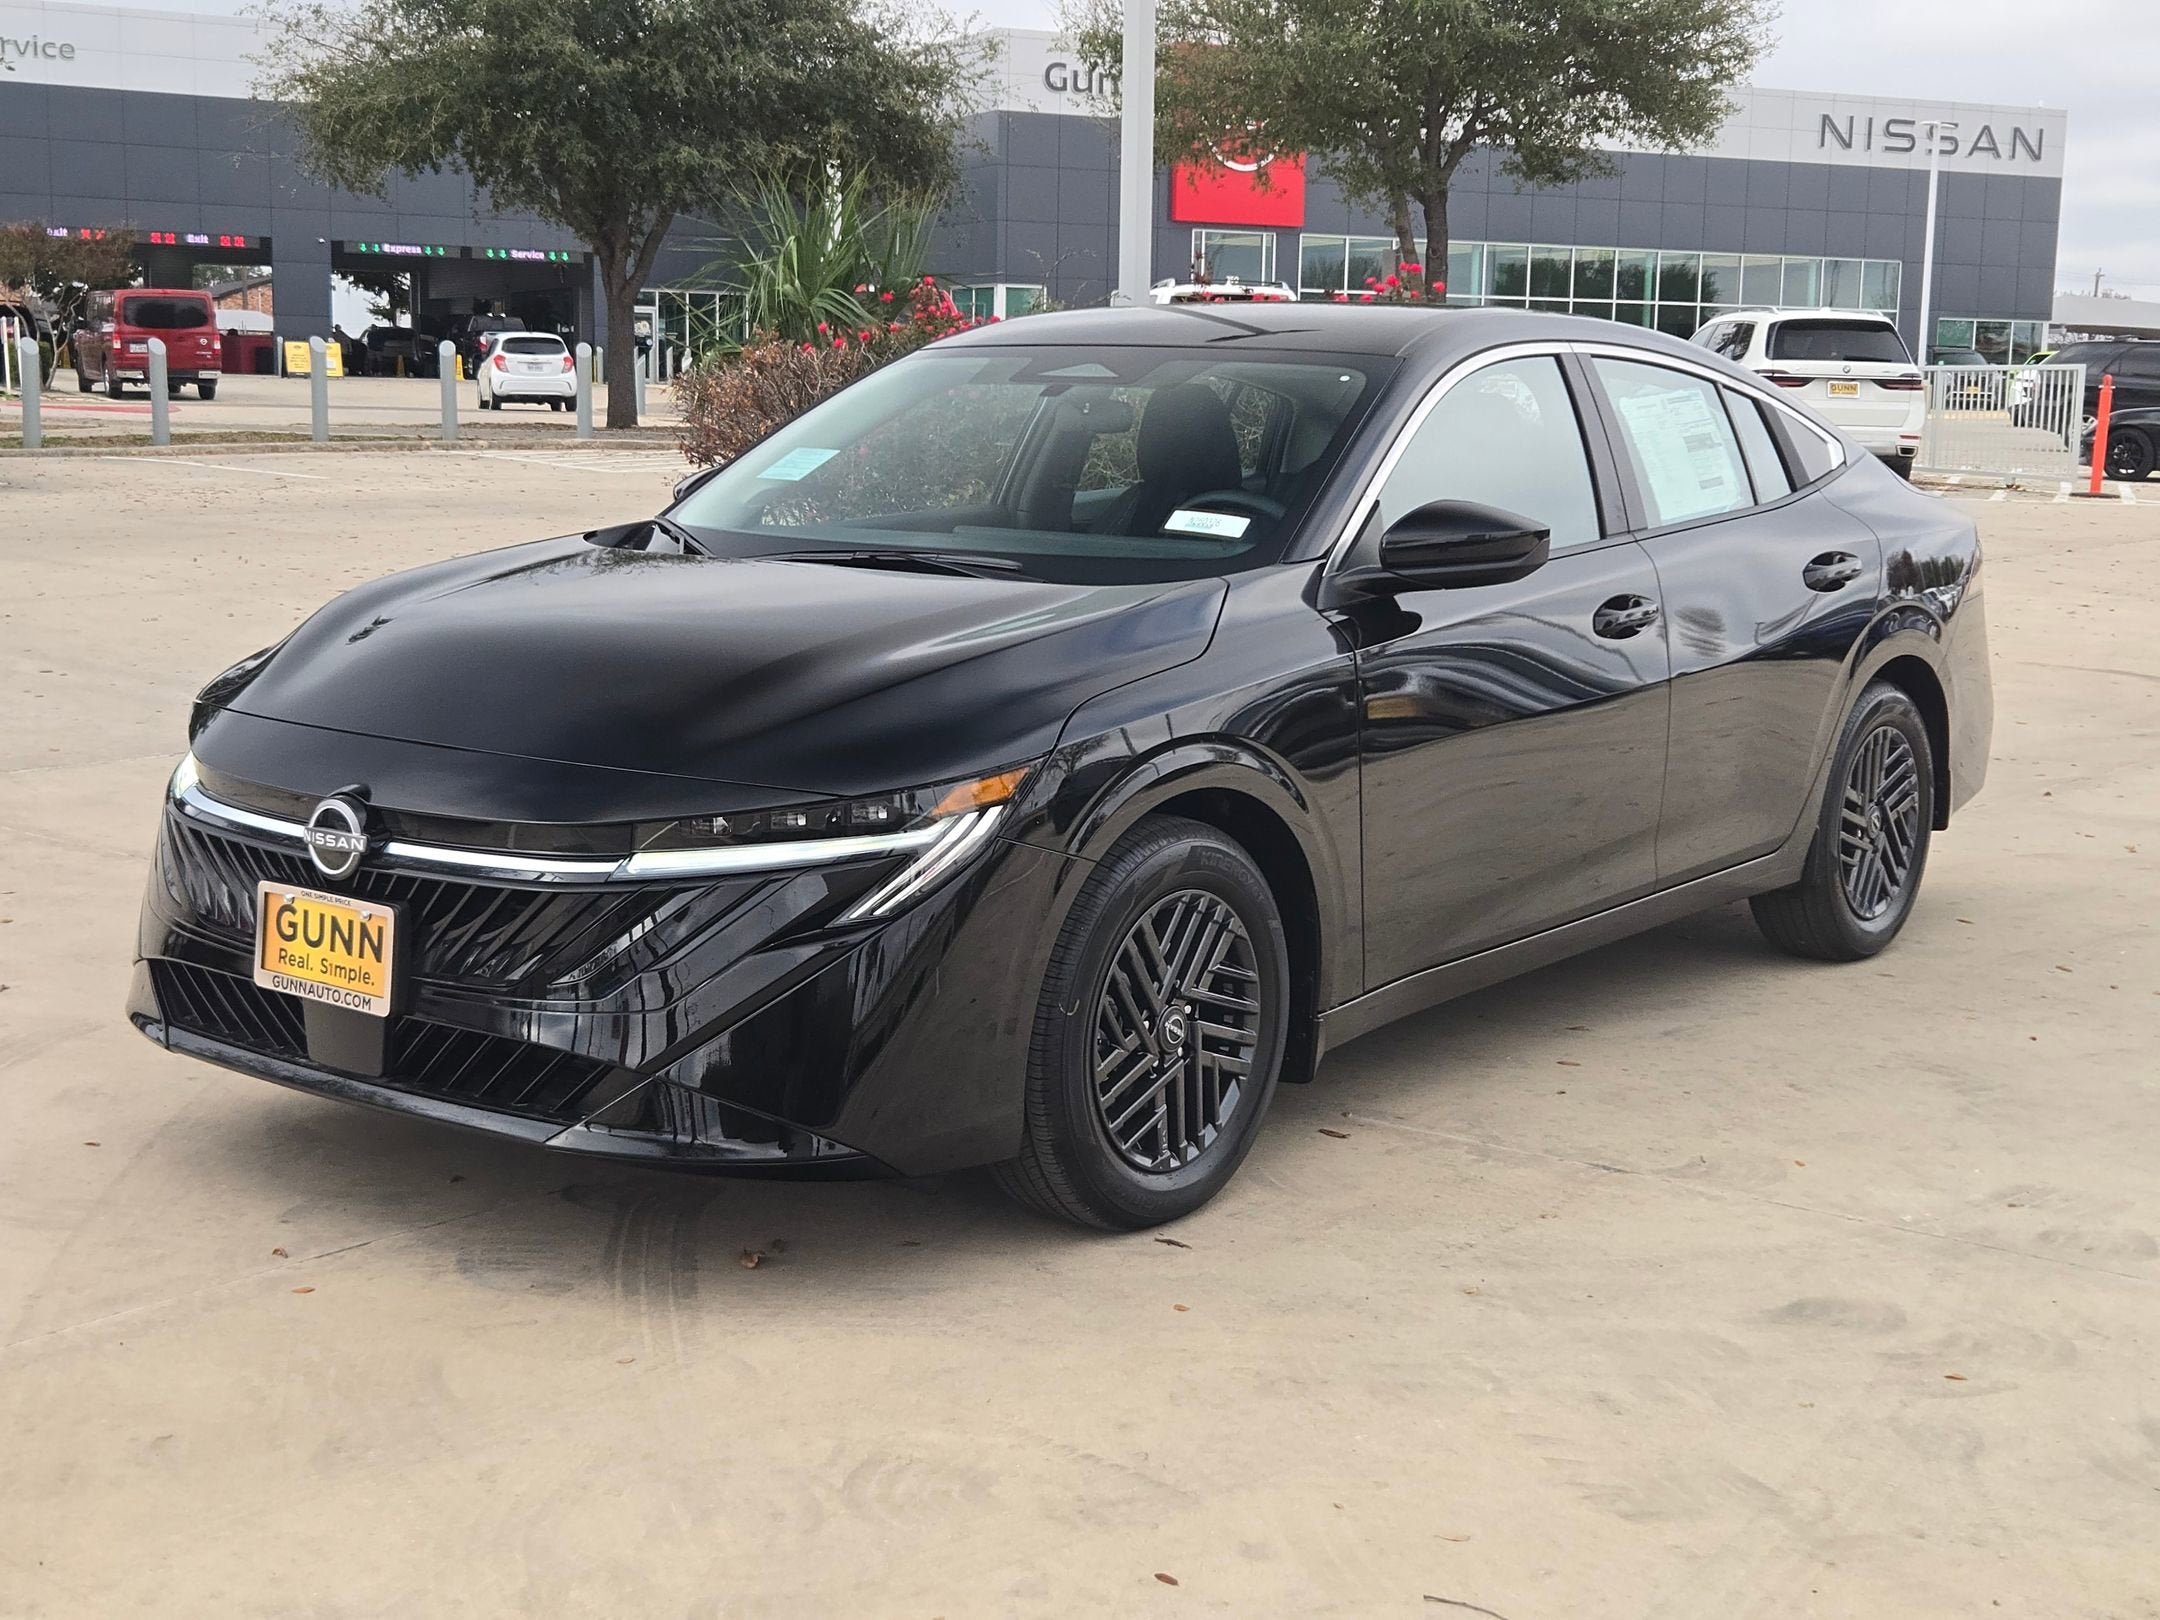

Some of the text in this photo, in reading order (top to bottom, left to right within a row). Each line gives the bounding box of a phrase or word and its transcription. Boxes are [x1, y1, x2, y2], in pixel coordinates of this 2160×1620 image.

[1819, 113, 2044, 162] NISSAN
[185, 233, 209, 244] Exit
[383, 243, 422, 254] Express
[510, 249, 545, 260] Service
[304, 829, 365, 851] NISSAN
[275, 903, 384, 963] GUNN
[278, 947, 314, 972] Real.
[272, 975, 372, 1011] GUNNAUTO.COM
